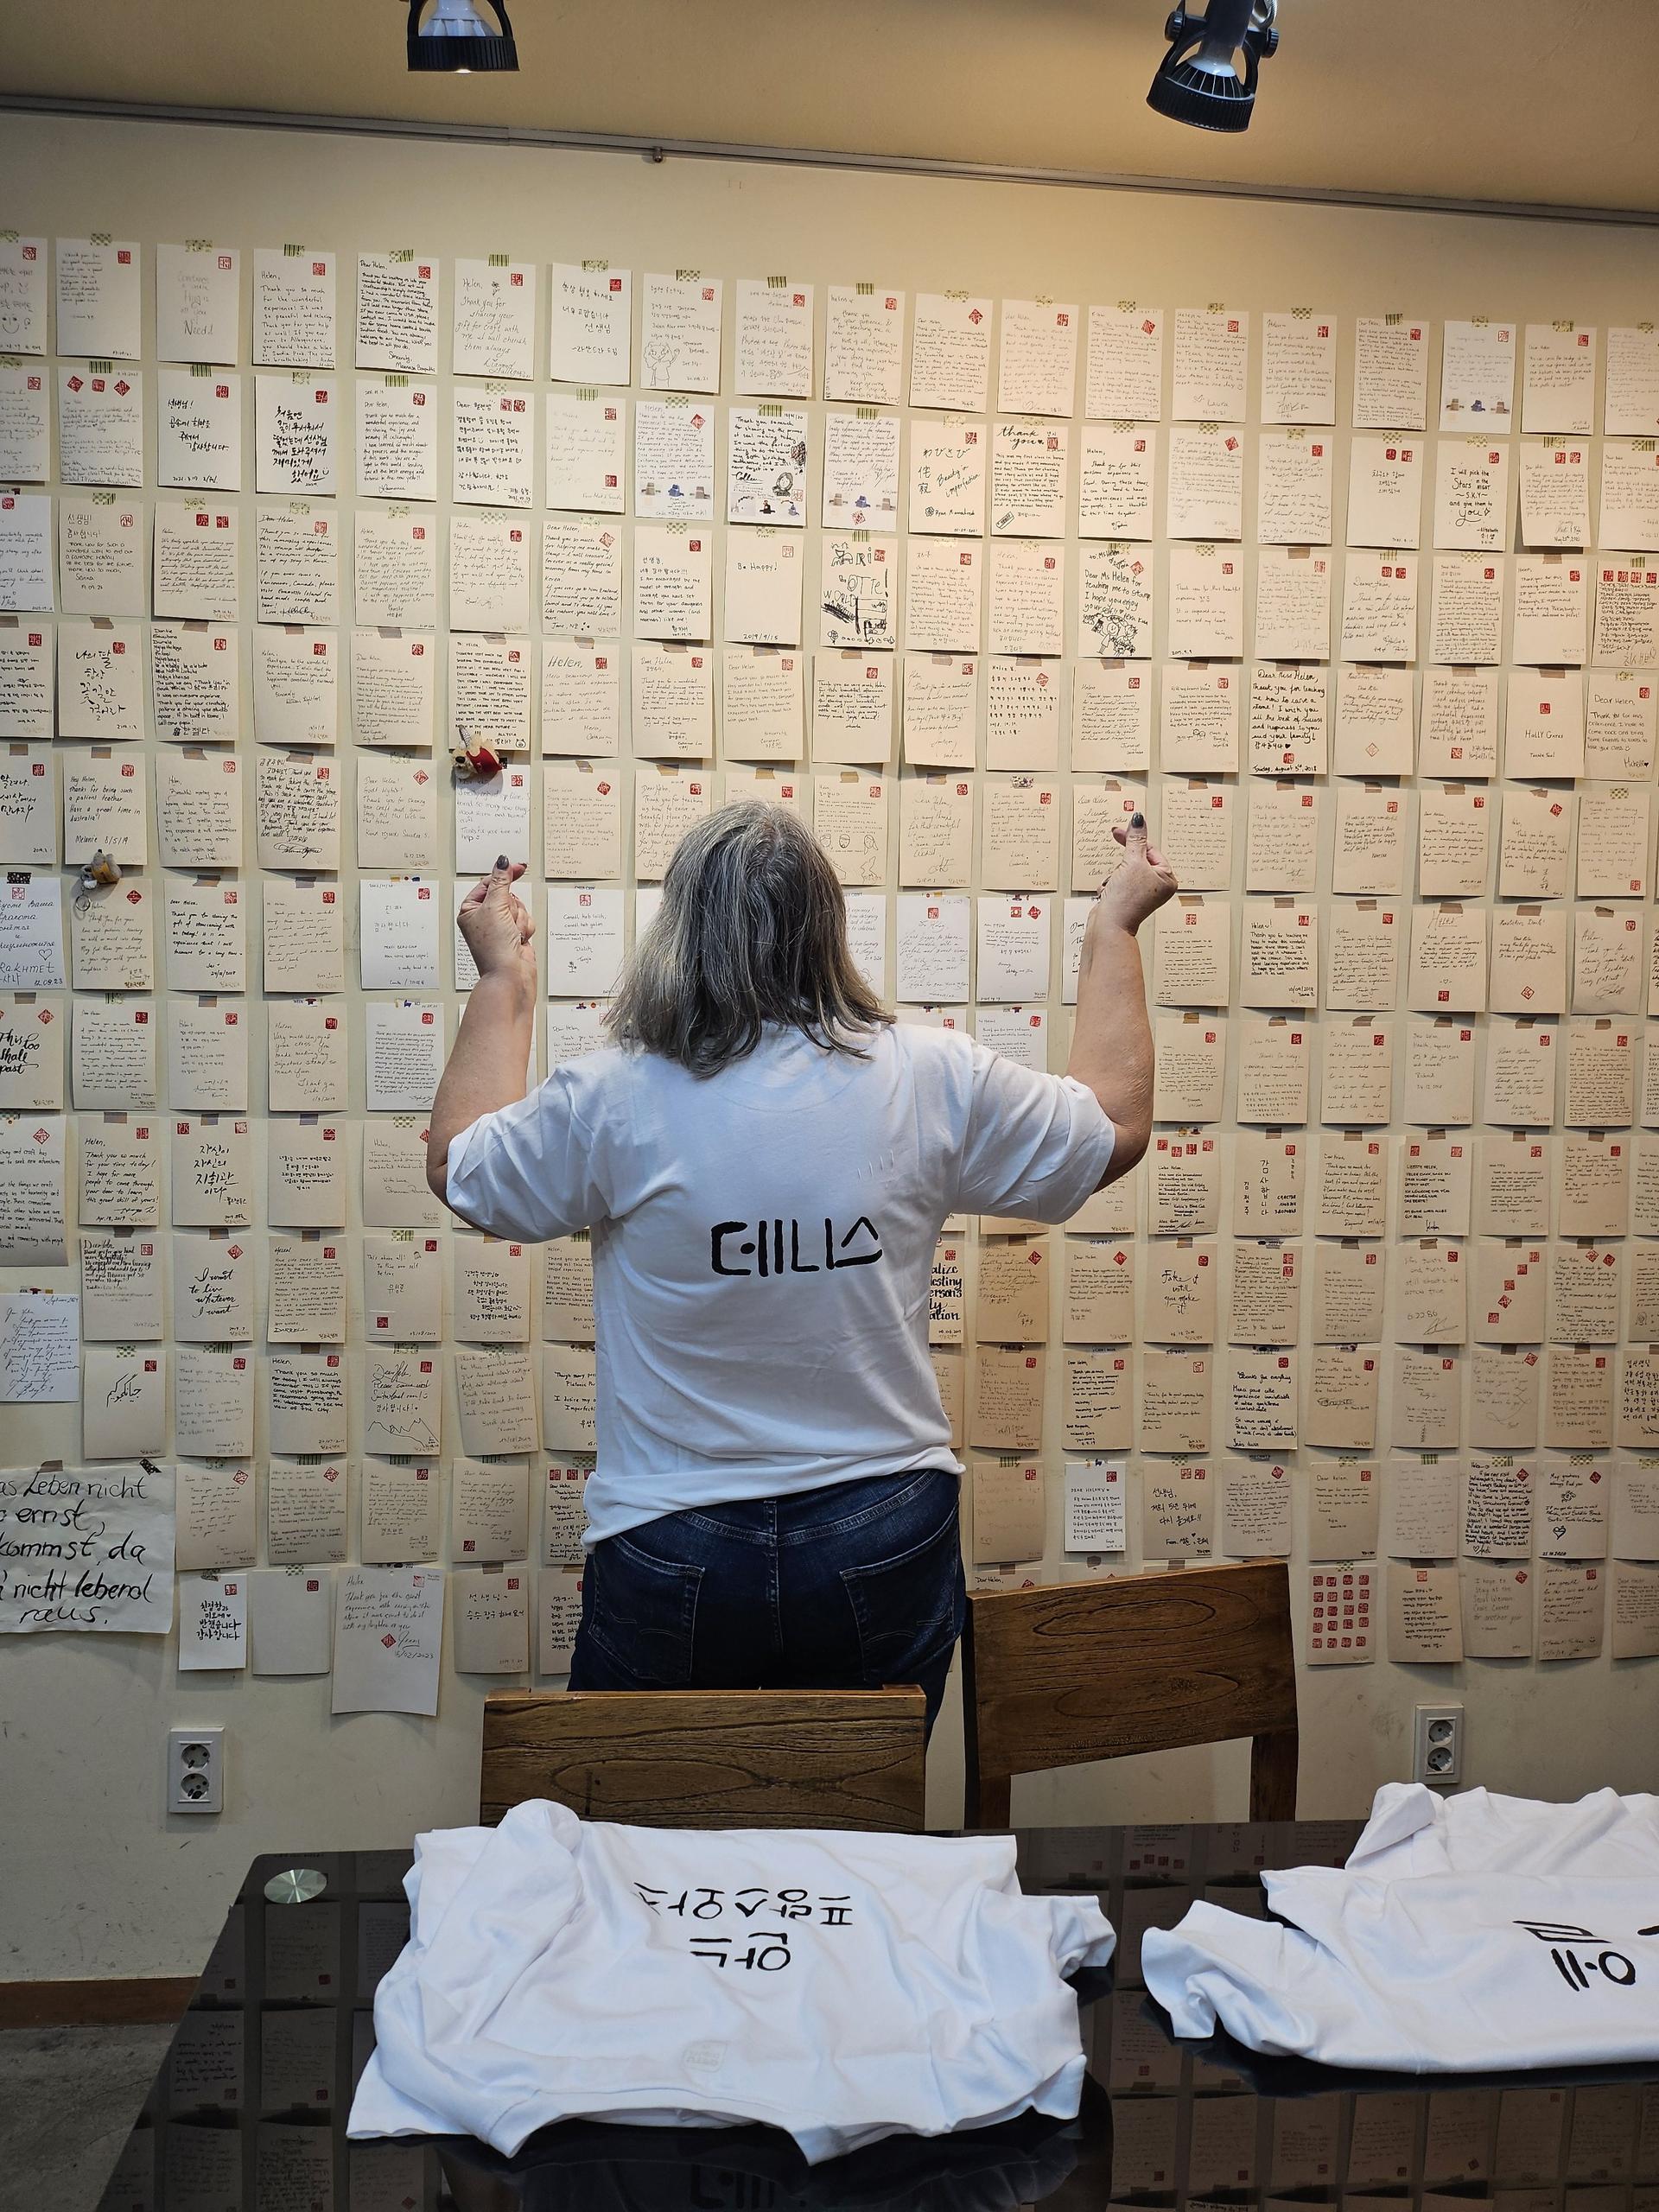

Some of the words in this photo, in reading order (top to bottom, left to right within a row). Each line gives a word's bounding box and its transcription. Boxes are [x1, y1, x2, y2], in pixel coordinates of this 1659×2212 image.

[998, 425, 1039, 437] thank
[1009, 438, 1037, 450] you
[1452, 477, 1471, 490] Stars
[1455, 510, 1483, 527] you
[750, 562, 778, 572] Happy!
[1085, 569, 1098, 579] Dear
[1113, 570, 1129, 583] Helen
[1132, 576, 1142, 588] for
[1085, 581, 1109, 594] teaching
[1085, 591, 1090, 600] I
[1092, 593, 1106, 603] hope
[1108, 598, 1122, 607] you
[1122, 598, 1139, 611] enjoy
[1258, 669, 1276, 679] Dear
[1293, 671, 1318, 683] Helen,
[1253, 683, 1273, 691] Thank
[1274, 685, 1287, 695] you
[1289, 684, 1301, 694] for
[1595, 695, 1612, 703] Dear
[1304, 708, 1319, 718] you
[71, 776, 79, 786] Hey
[90, 785, 99, 793] for
[102, 785, 117, 795] being
[22, 1033, 40, 1051] too
[0, 1063, 40, 1074] past
[85, 1137, 105, 1147] Helen,
[105, 1153, 118, 1163] you
[209, 1268, 235, 1281] want
[188, 1284, 200, 1294] to
[195, 1293, 236, 1305] whatever
[23, 1471, 80, 1497] Leben
[87, 1476, 148, 1499] nicht
[1160, 1516, 1173, 1524] 다시
[108, 1530, 146, 1566] da
[14, 1569, 67, 1602] nicht
[74, 1569, 154, 1604] lebend
[195, 1629, 240, 1641] 감사합니다
[690, 1932, 791, 1971] 안느
